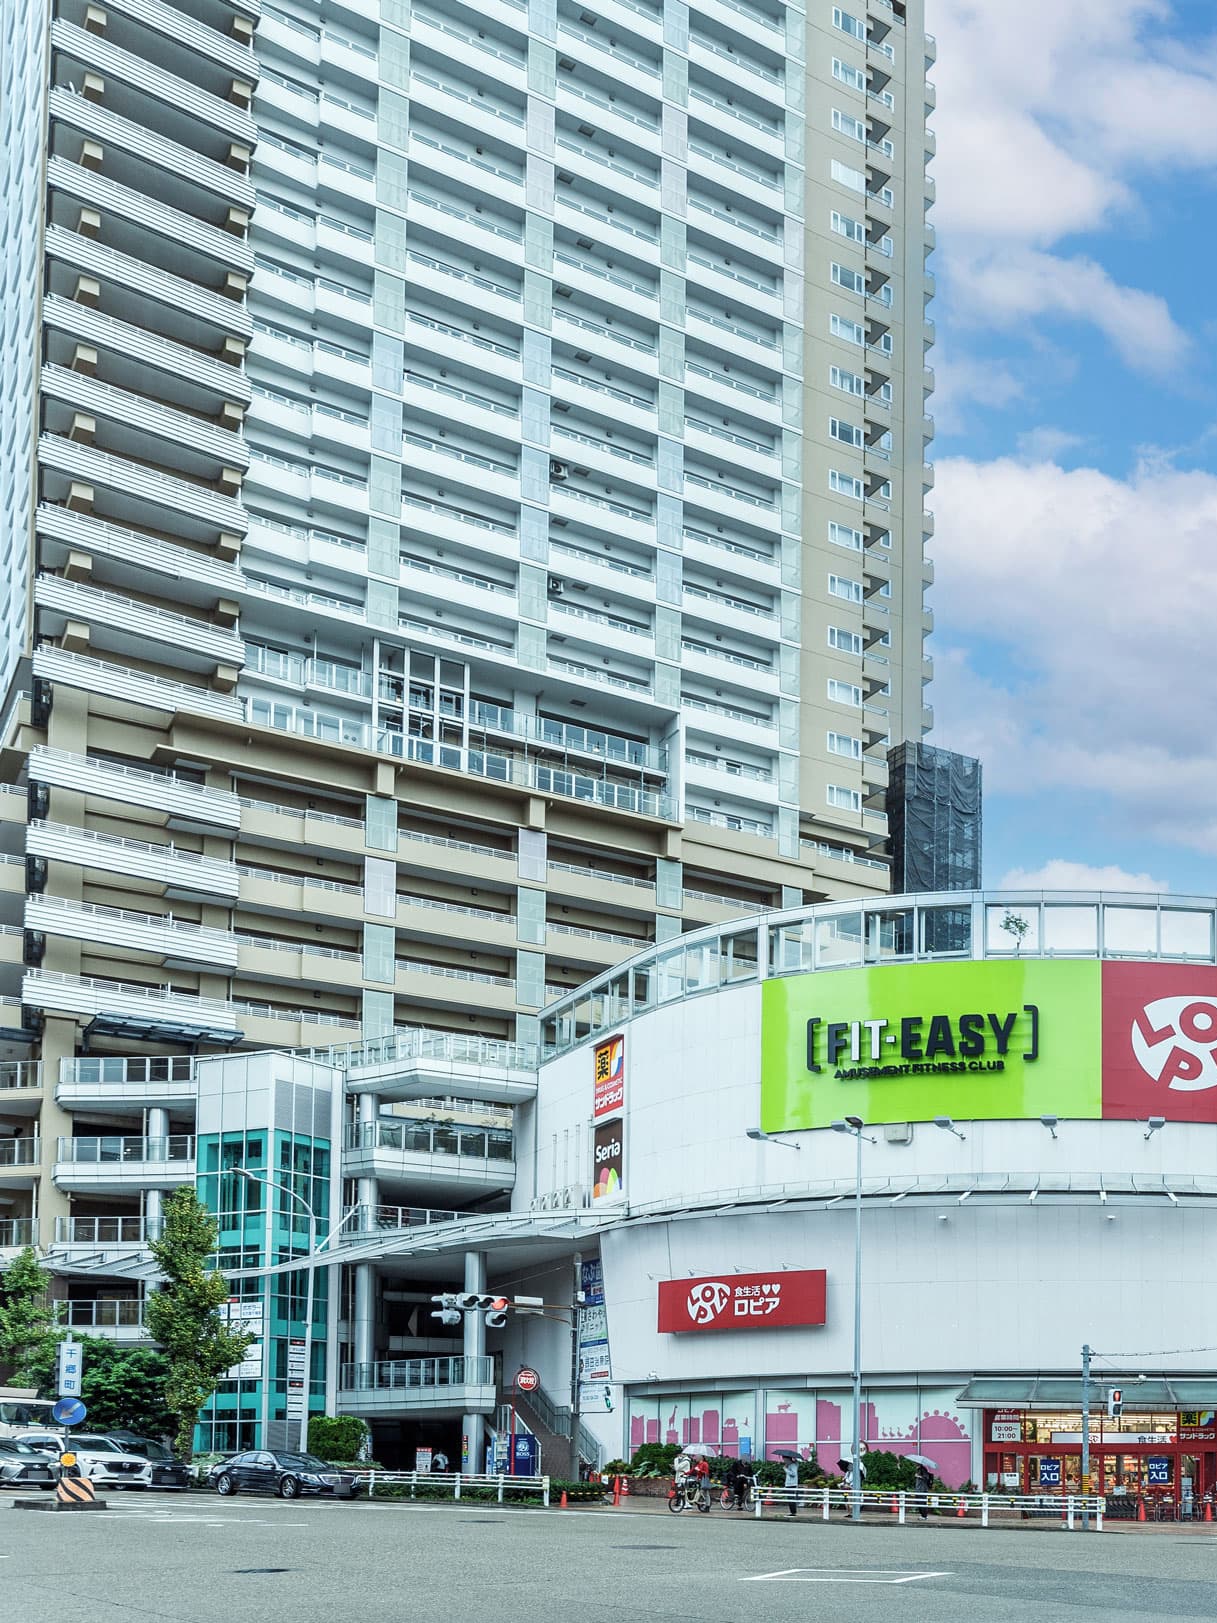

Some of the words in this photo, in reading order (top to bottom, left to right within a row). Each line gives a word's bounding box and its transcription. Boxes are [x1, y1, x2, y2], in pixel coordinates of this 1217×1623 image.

[597, 1049, 609, 1081] 薬
[834, 1064, 911, 1080] AMUSEMENT
[912, 1061, 966, 1075] FITNESS
[968, 1060, 1005, 1072] CLUB
[595, 1086, 623, 1110] サンドラッグ
[595, 1137, 621, 1163] Seria
[734, 1285, 761, 1297] 食生活
[734, 1297, 780, 1316] ロピア
[1041, 1472, 1059, 1481] 入口
[1150, 1471, 1168, 1480] 入口
